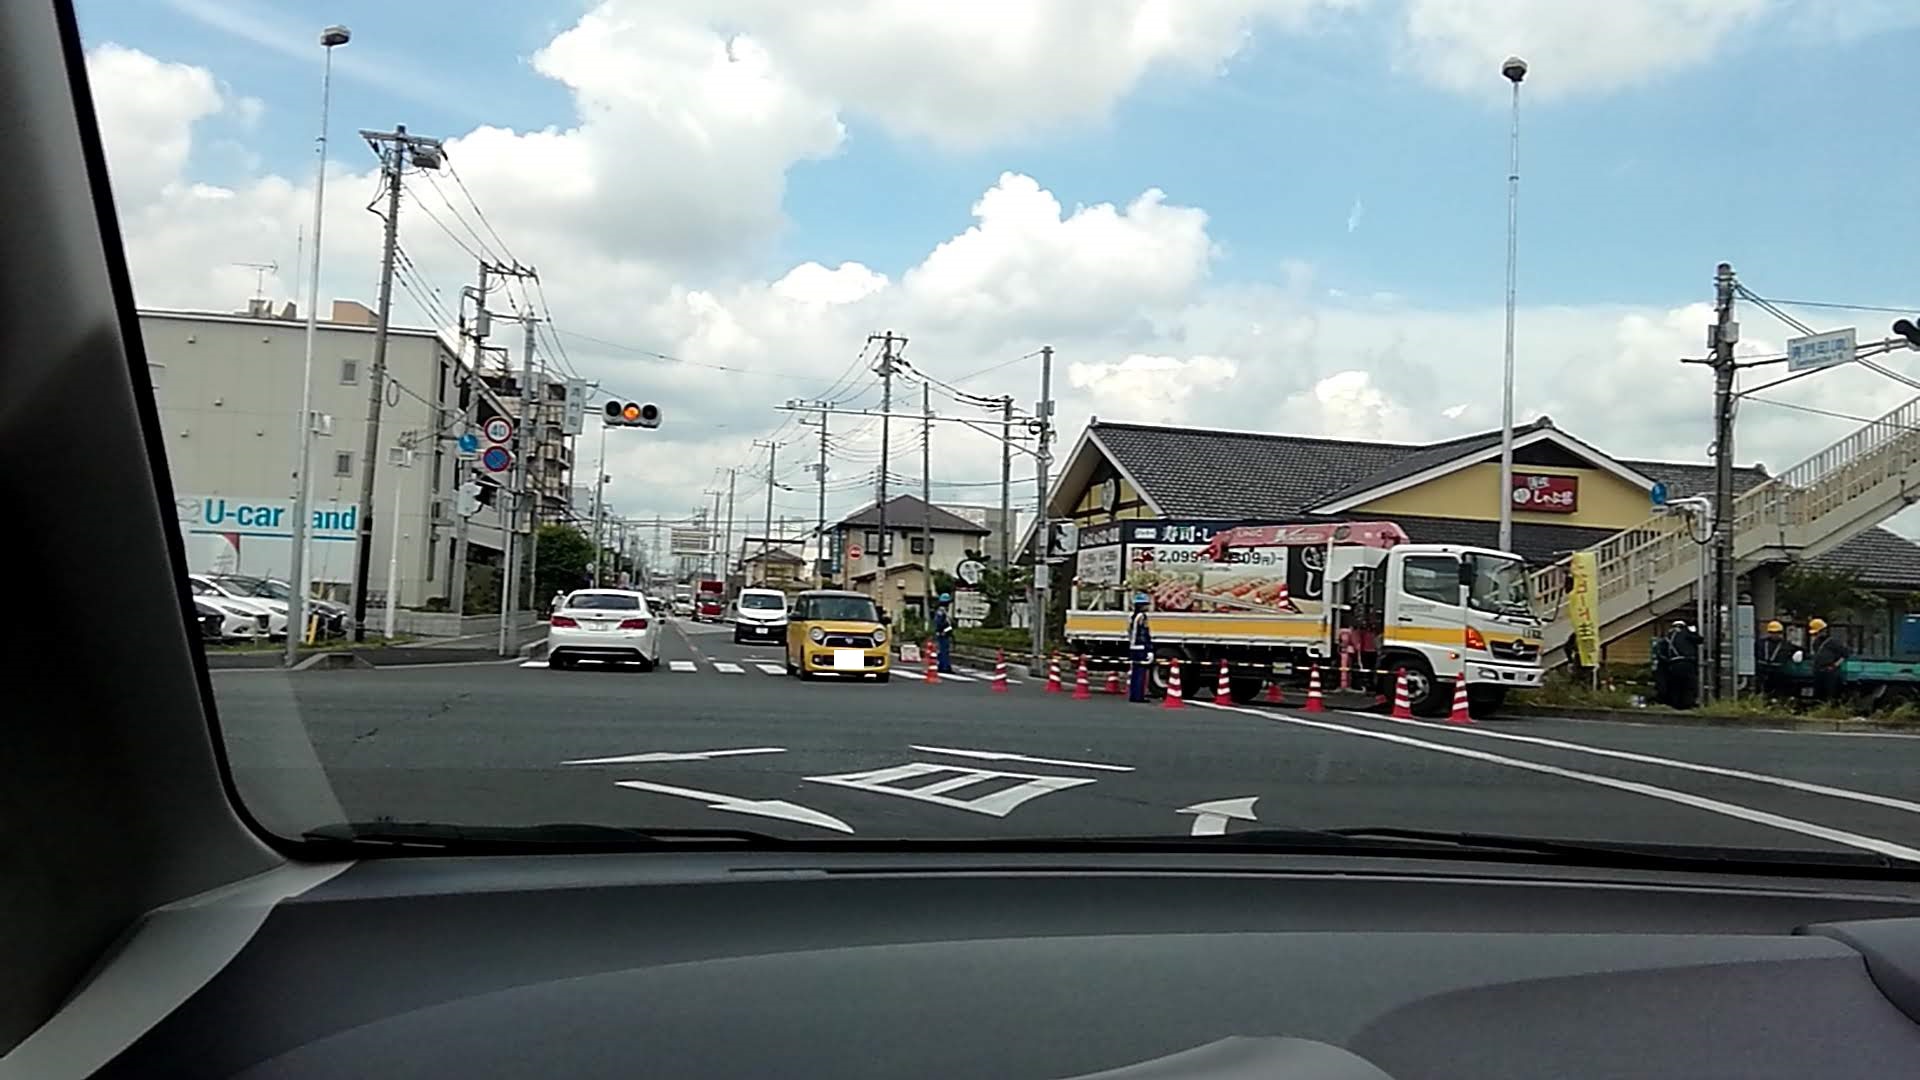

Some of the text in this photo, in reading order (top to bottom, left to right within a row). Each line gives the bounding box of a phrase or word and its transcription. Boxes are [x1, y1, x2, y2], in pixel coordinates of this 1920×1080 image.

[490, 424, 507, 437] 40
[205, 498, 357, 531] U-car and
